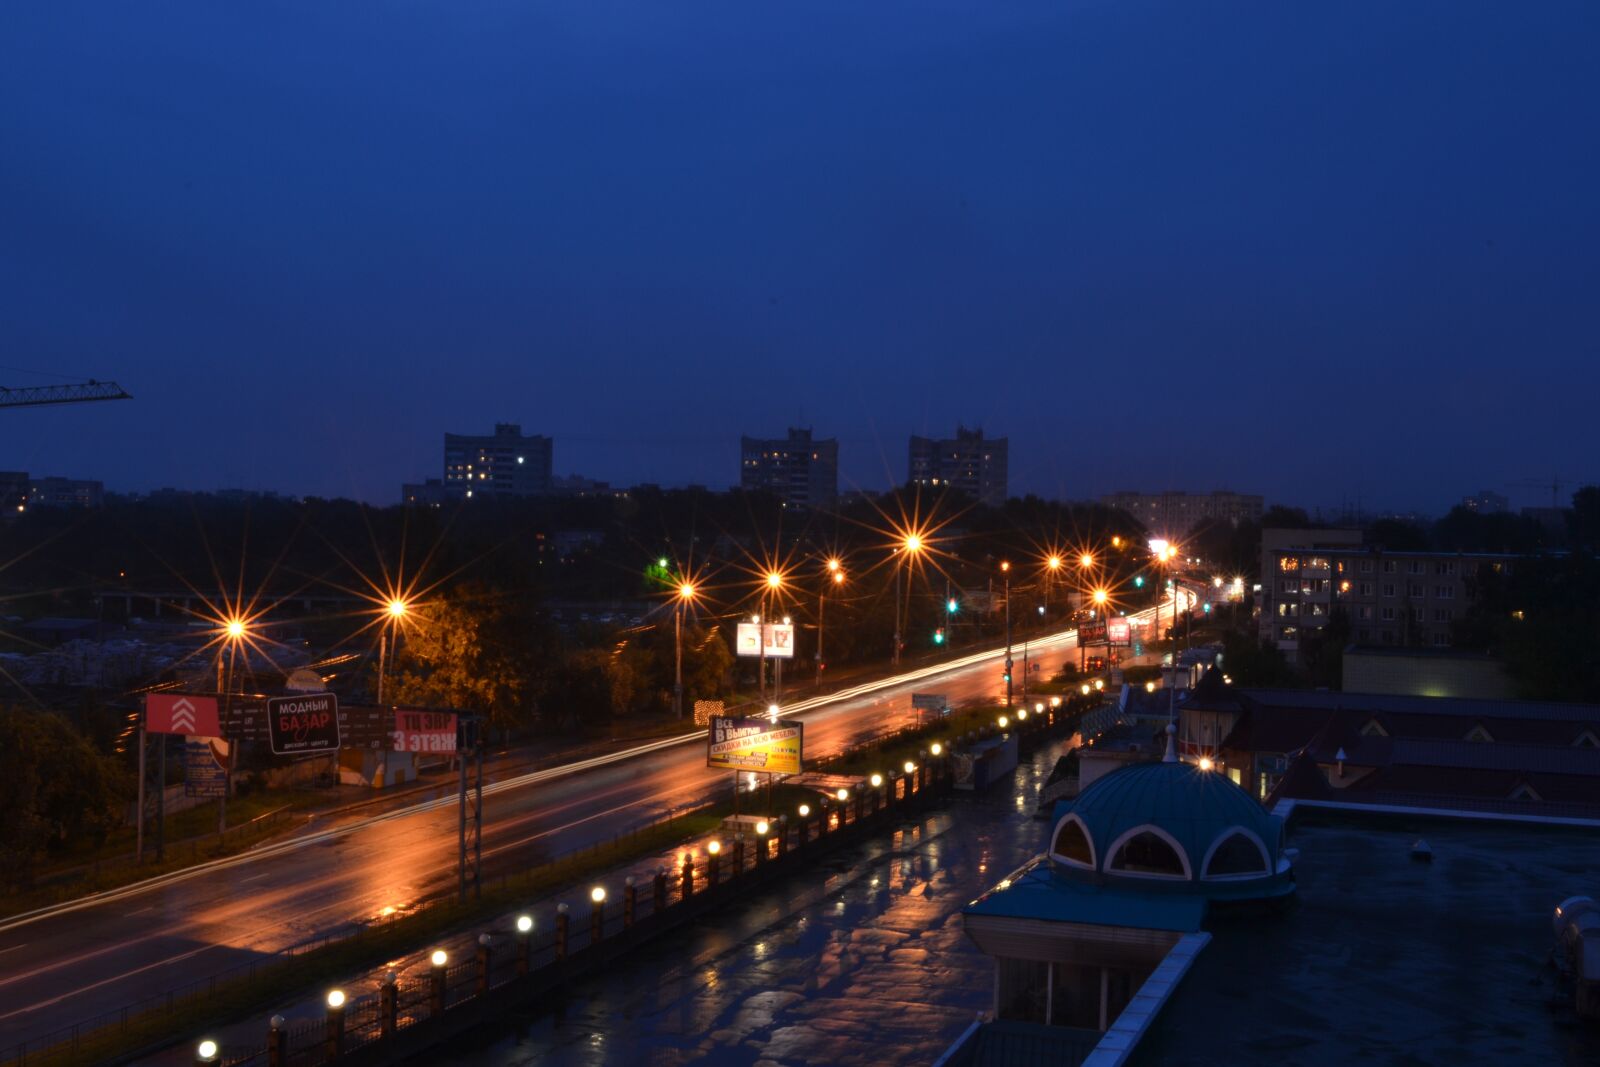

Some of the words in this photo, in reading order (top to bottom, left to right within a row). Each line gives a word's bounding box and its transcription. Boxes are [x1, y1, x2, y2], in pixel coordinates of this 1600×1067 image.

[279, 700, 329, 714] МОДНЫЙ
[279, 712, 330, 739] БАЗАР
[716, 718, 733, 729] ВСЕ
[392, 730, 406, 751] 3
[409, 732, 457, 751] этаж
[713, 741, 742, 752] СКИДКИ
[743, 737, 753, 747] НА
[770, 729, 796, 740] МЕБЕЛЬ
[715, 729, 725, 743] В
